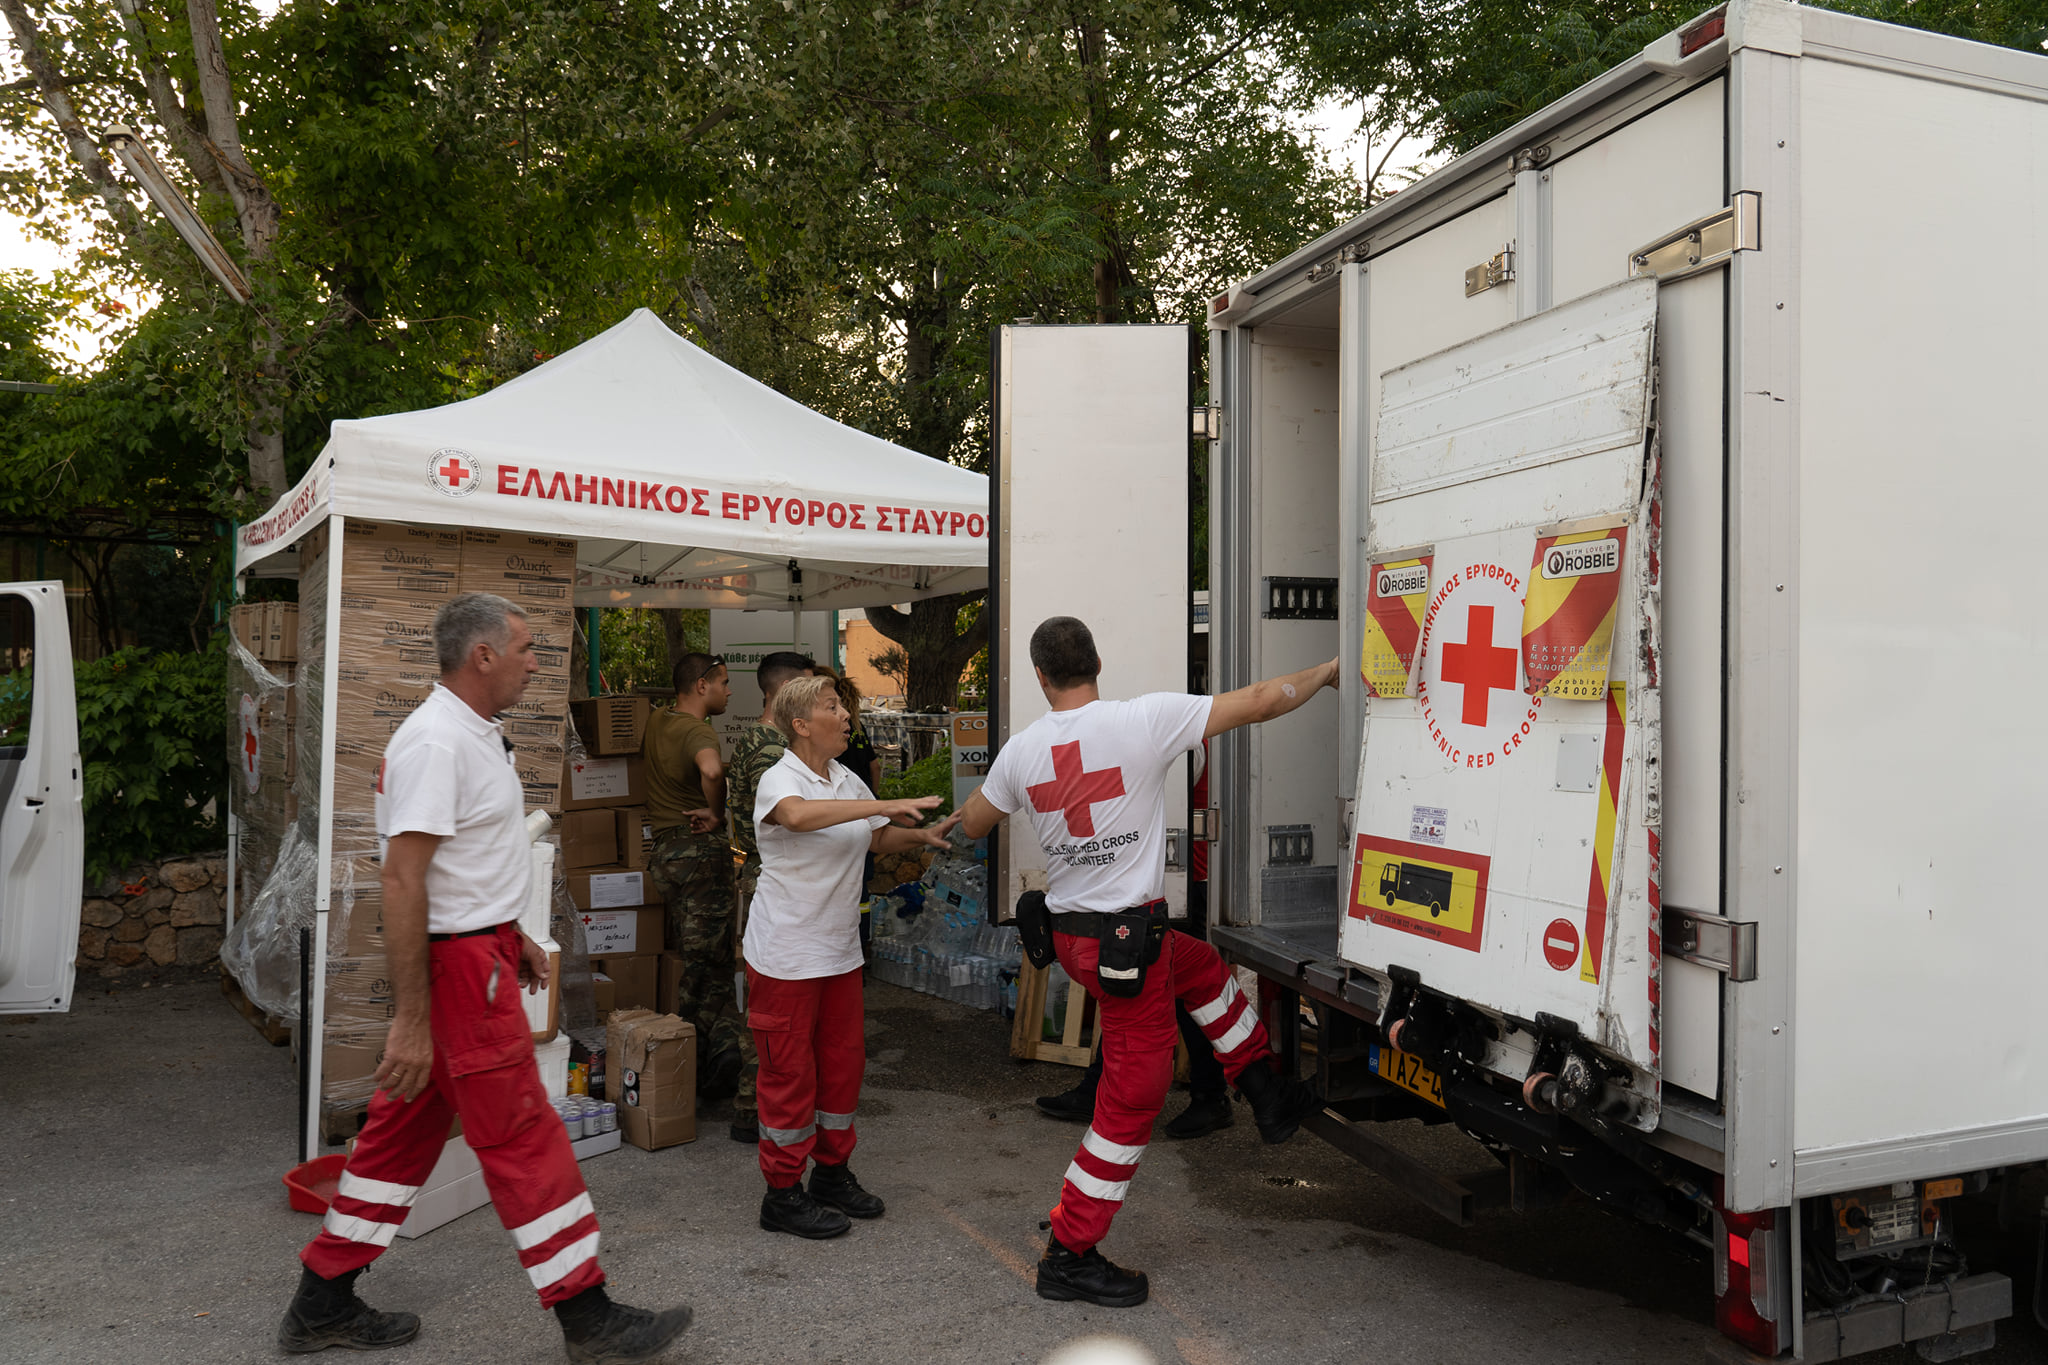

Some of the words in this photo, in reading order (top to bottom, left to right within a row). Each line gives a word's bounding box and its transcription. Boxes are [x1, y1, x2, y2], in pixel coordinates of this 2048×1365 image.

[497, 464, 711, 517] ΕΛΛΗΝΙΚΟΣ
[722, 491, 866, 530] ΕΡΥΘΡΟΣ
[876, 506, 990, 539] ΣΤΑΥΡΟ
[1585, 545, 1603, 553] LOVE
[1565, 552, 1615, 571] ROBBIE
[1391, 576, 1426, 592] ROBBIE
[1421, 573, 1460, 658] ΕΛΛΗΝΙΚΟΣ
[1466, 563, 1520, 592] ΕΡΥΘΡΟΣ
[376, 691, 427, 708] Ολική
[1418, 681, 1460, 763] HELLENIC
[1467, 752, 1495, 768] RED
[1503, 695, 1542, 756] CROSS
[1102, 831, 1139, 849] CROSS
[1063, 852, 1116, 867] VOLUNTEER
